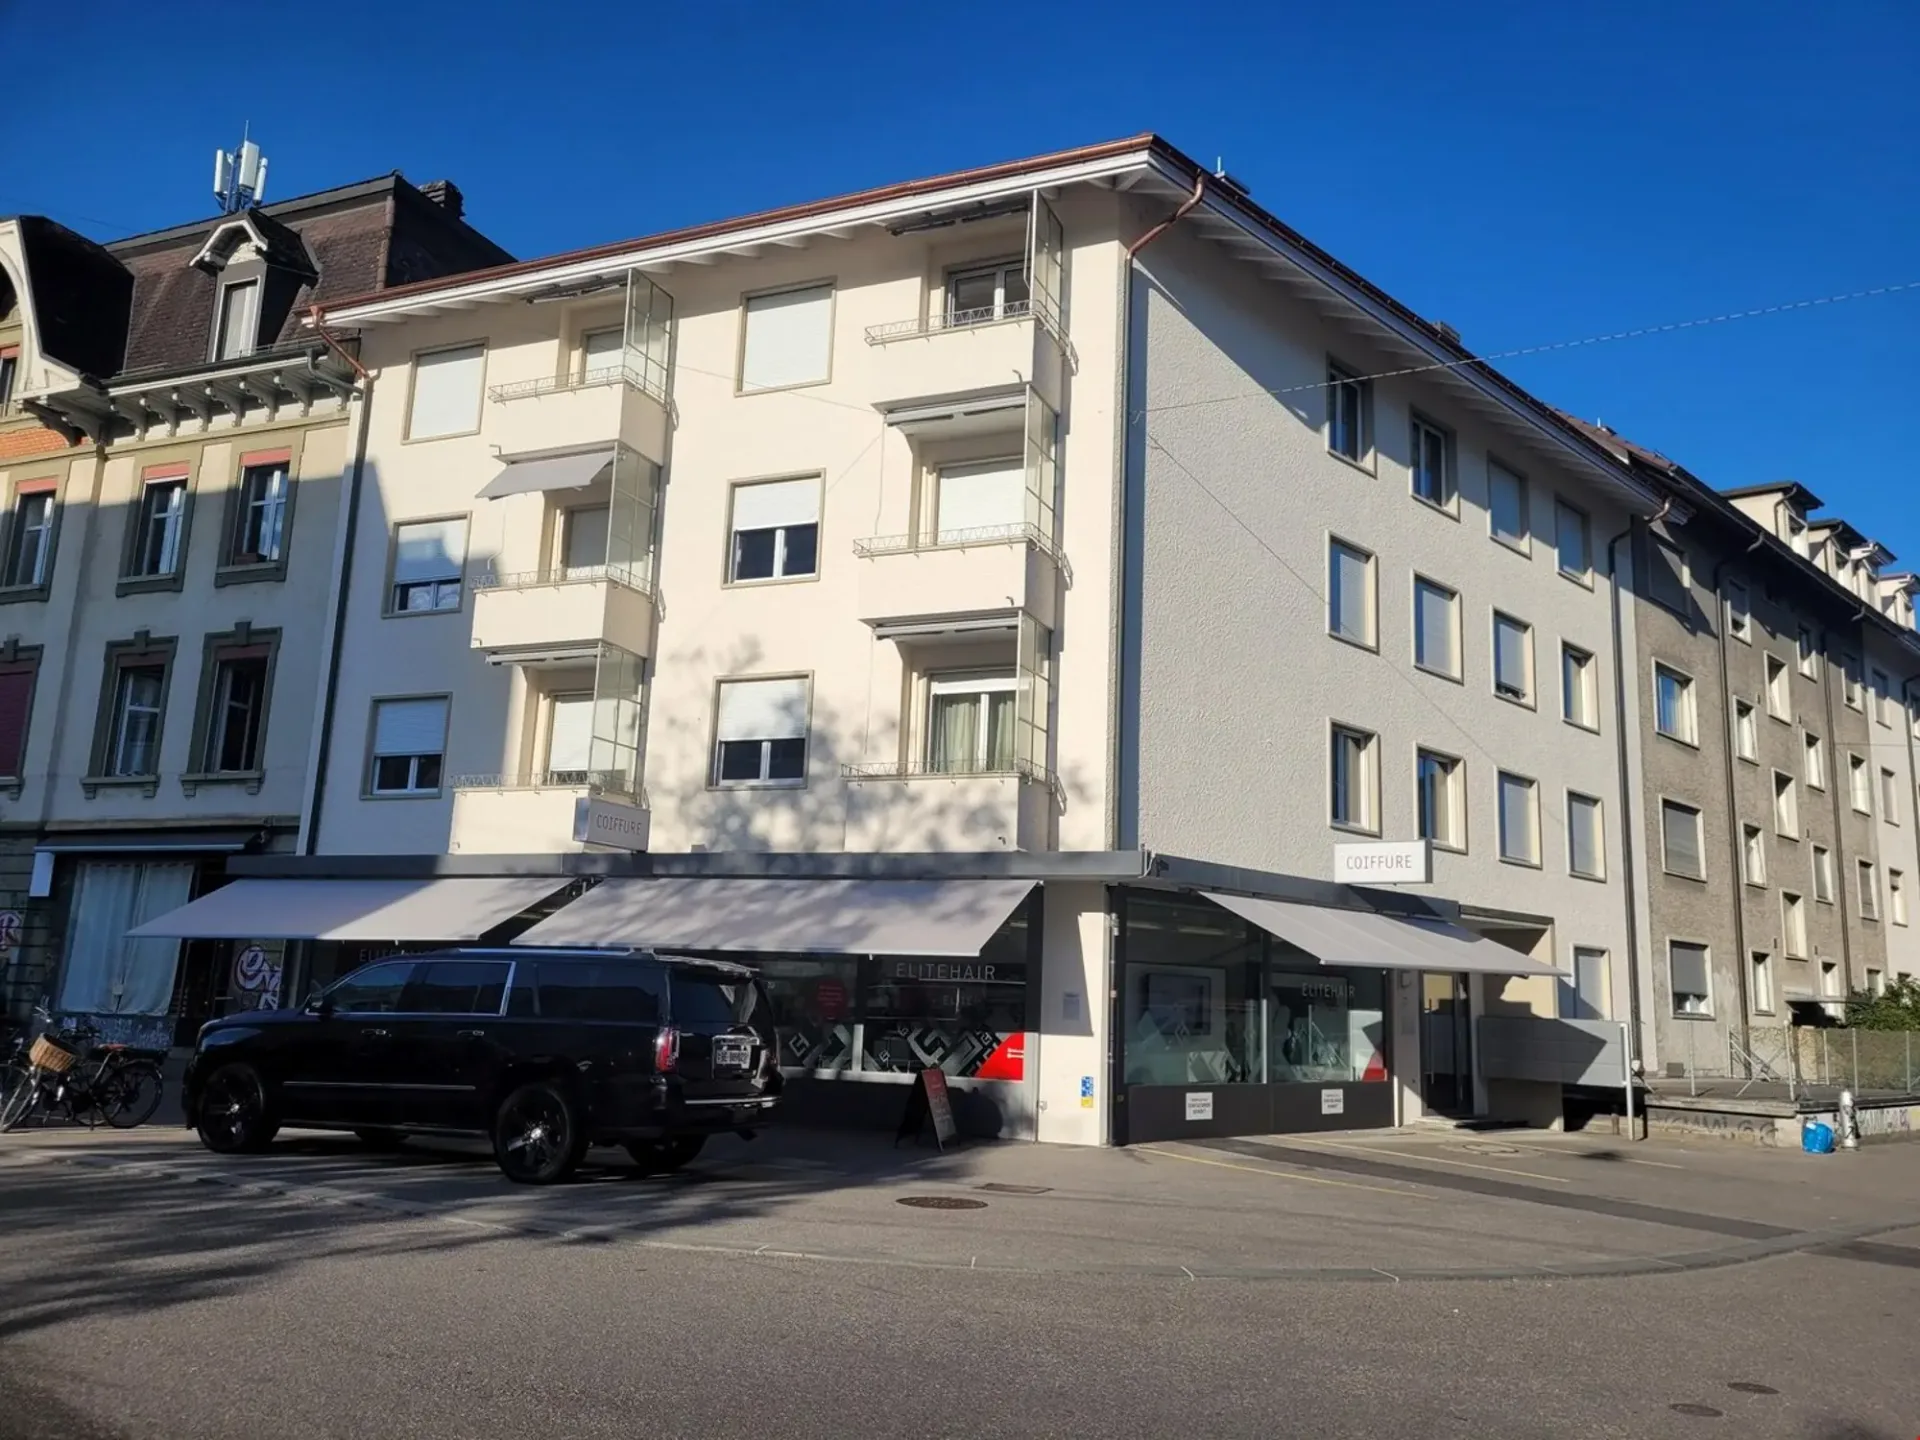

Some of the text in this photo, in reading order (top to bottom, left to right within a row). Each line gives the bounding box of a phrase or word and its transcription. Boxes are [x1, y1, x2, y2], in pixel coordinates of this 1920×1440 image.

[596, 814, 643, 836] COIFFURE
[1346, 855, 1412, 870] COIFFURE
[896, 963, 996, 980] ELITEHAIR
[1302, 983, 1356, 998] ELITEHAIR
